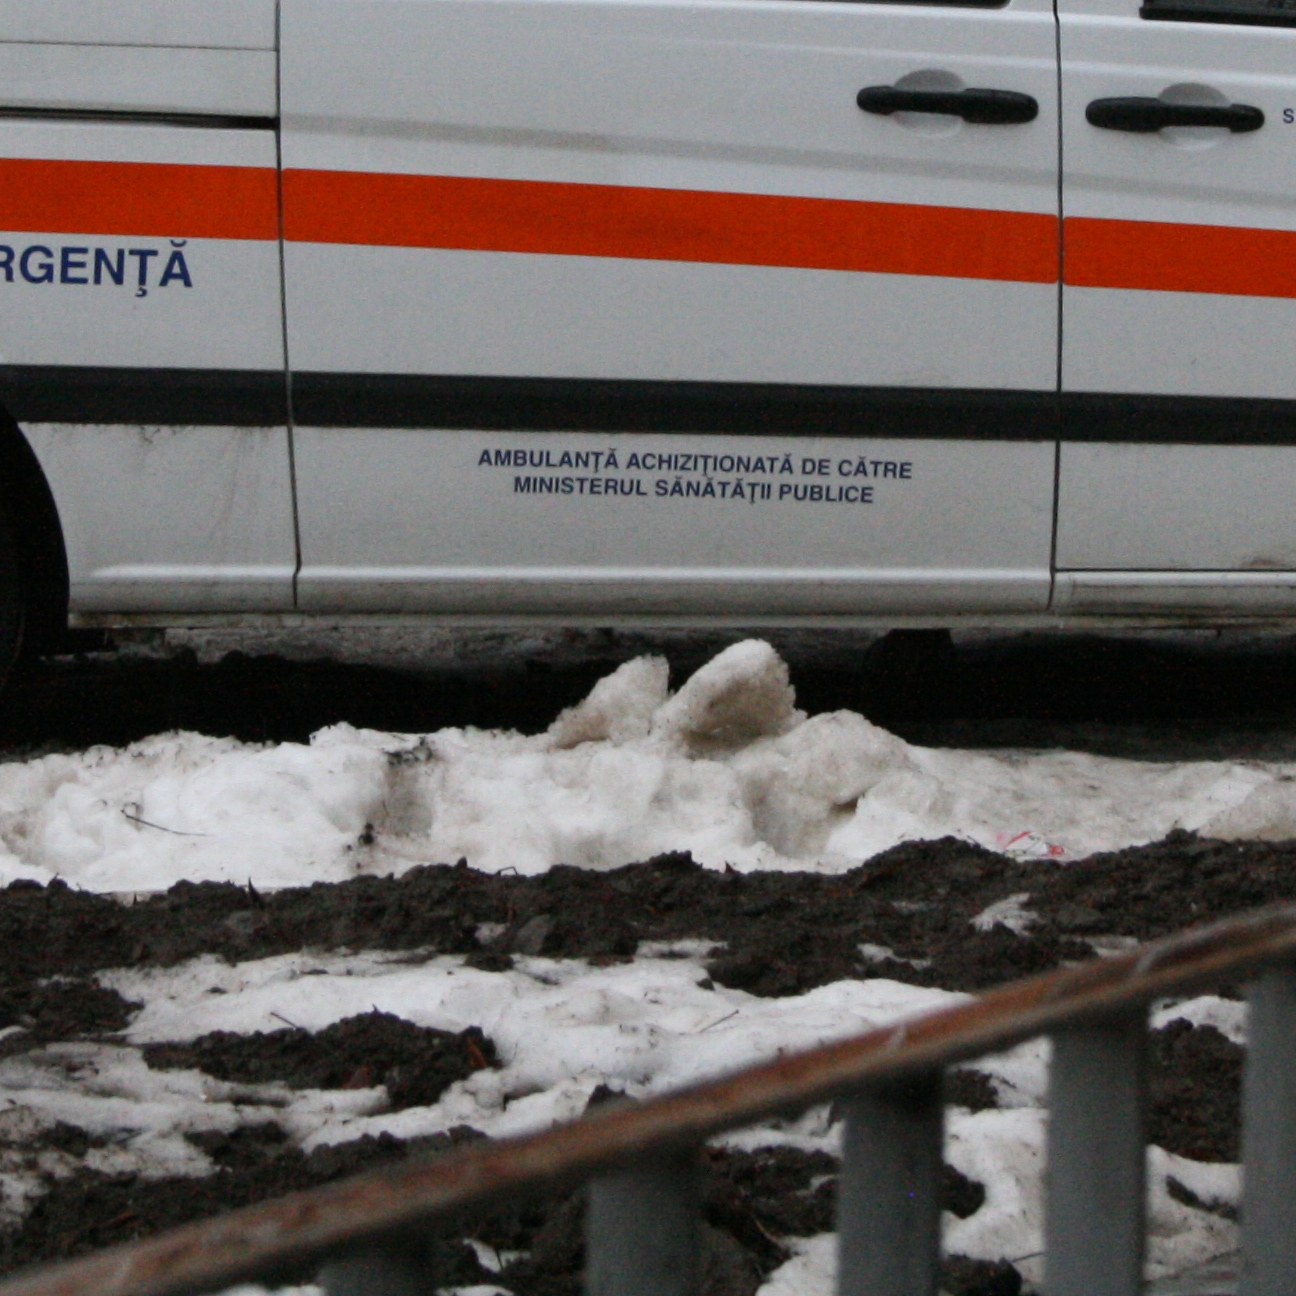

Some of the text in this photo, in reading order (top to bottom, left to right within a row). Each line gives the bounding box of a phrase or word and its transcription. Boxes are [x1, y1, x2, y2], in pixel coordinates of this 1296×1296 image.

[801, 458, 831, 475] DE
[838, 456, 913, 479] CĂTRE
[513, 476, 648, 495] MINISTERUL
[778, 483, 874, 503] PUBLICE
